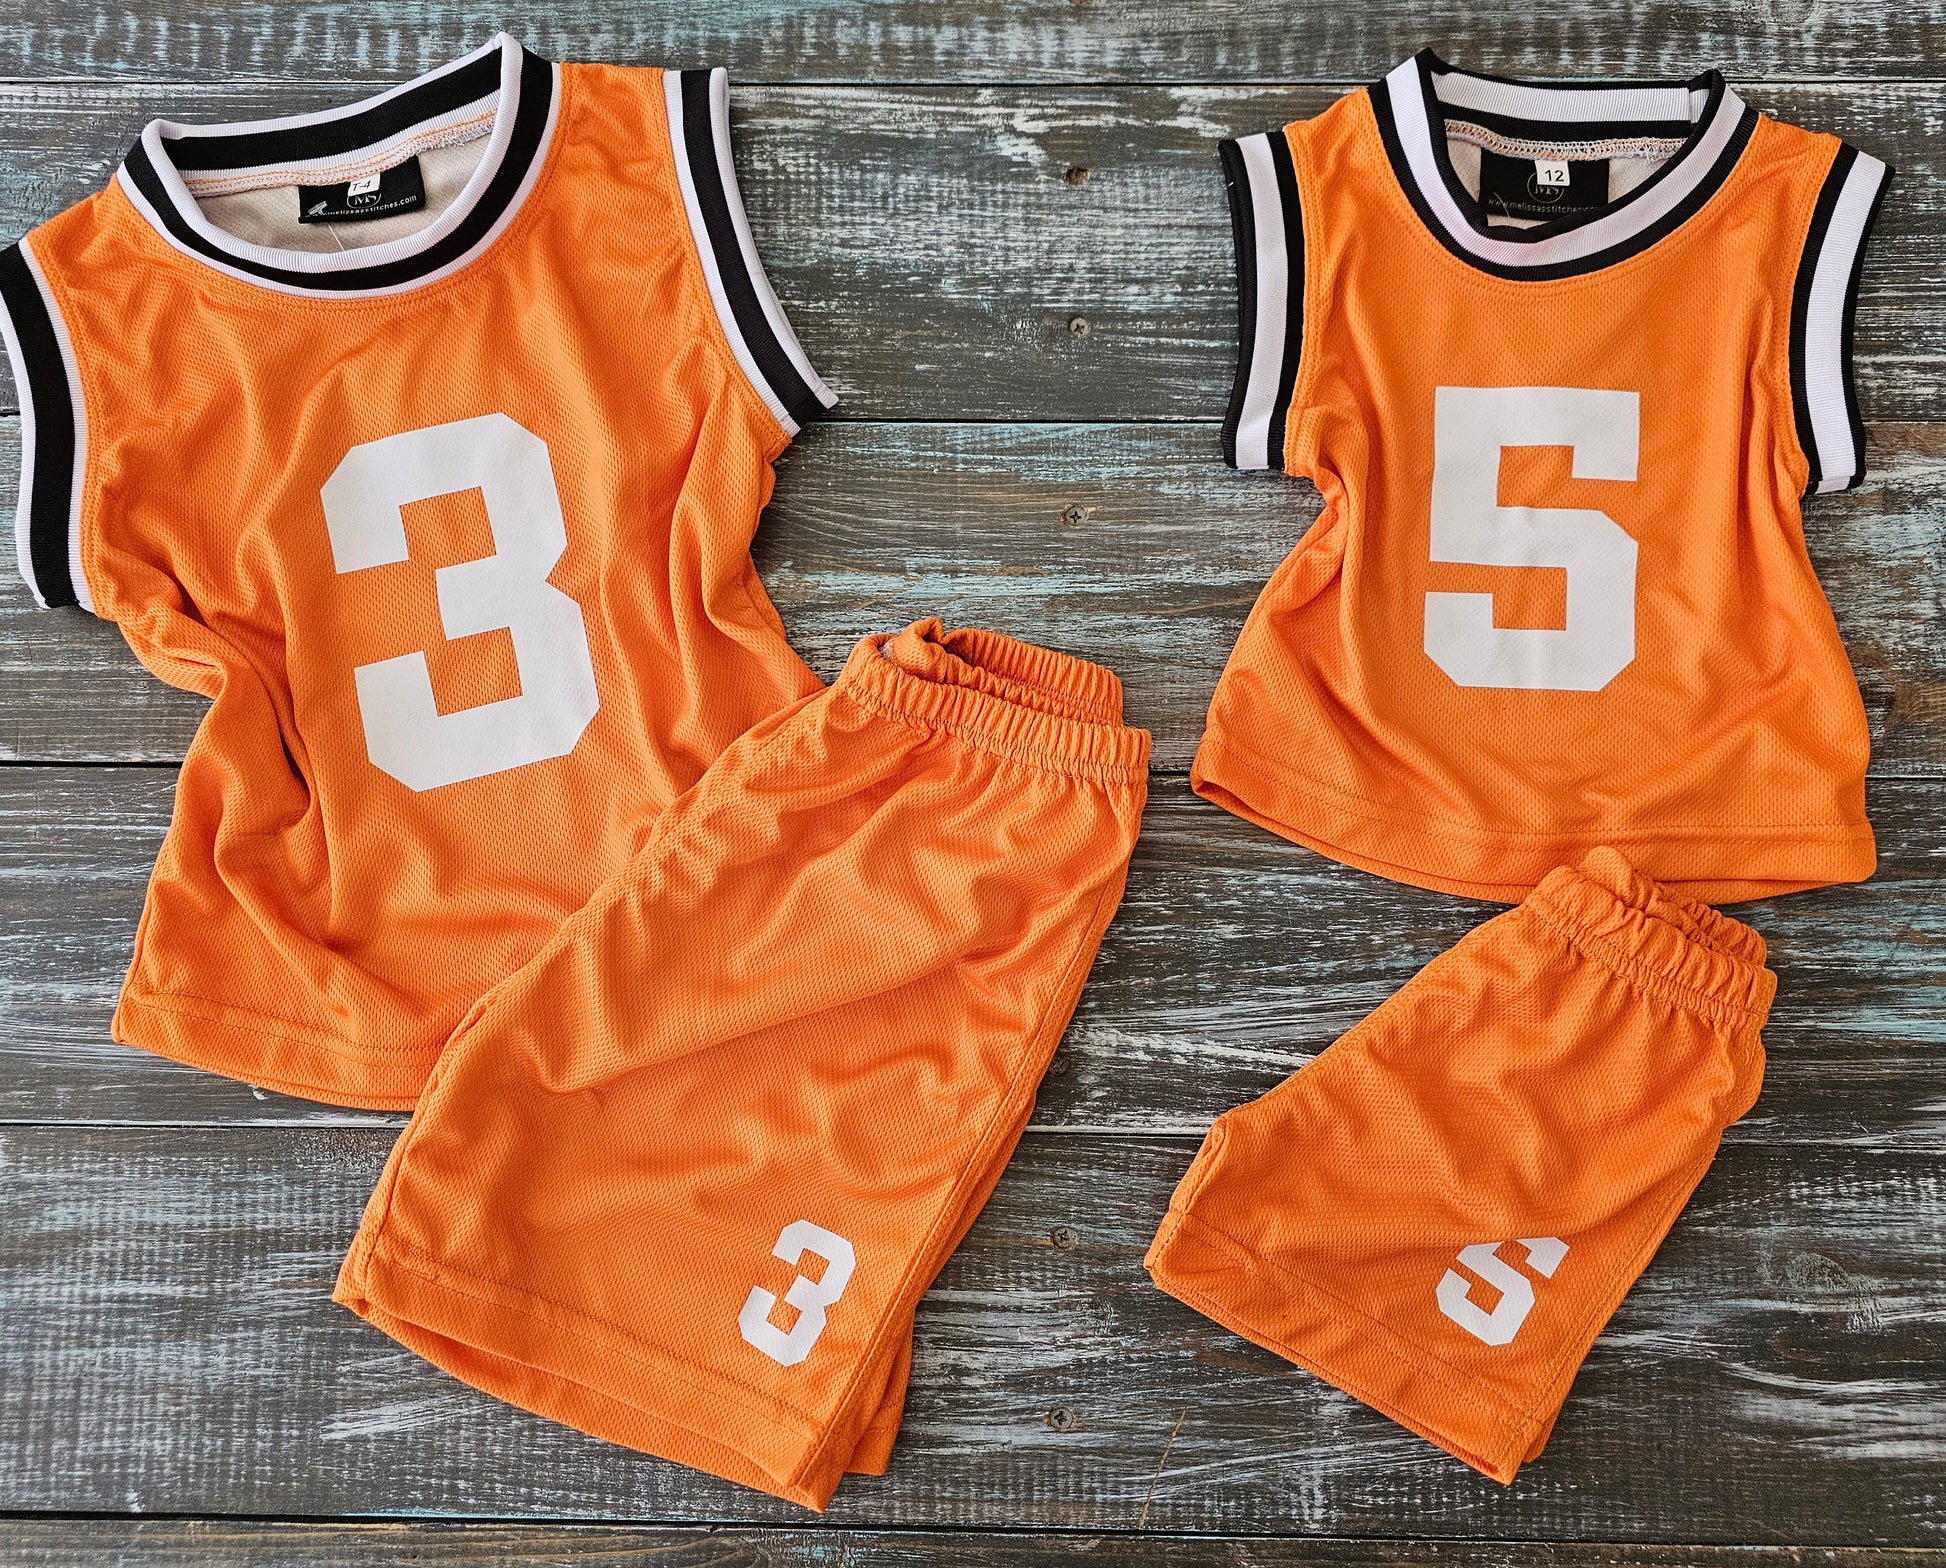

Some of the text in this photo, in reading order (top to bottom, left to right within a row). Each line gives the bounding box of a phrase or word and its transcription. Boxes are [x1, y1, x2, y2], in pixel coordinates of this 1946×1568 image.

[1545, 169, 1564, 182] 12
[321, 413, 600, 792] 3
[1424, 387, 1639, 691] 5
[739, 1220, 856, 1366] 3
